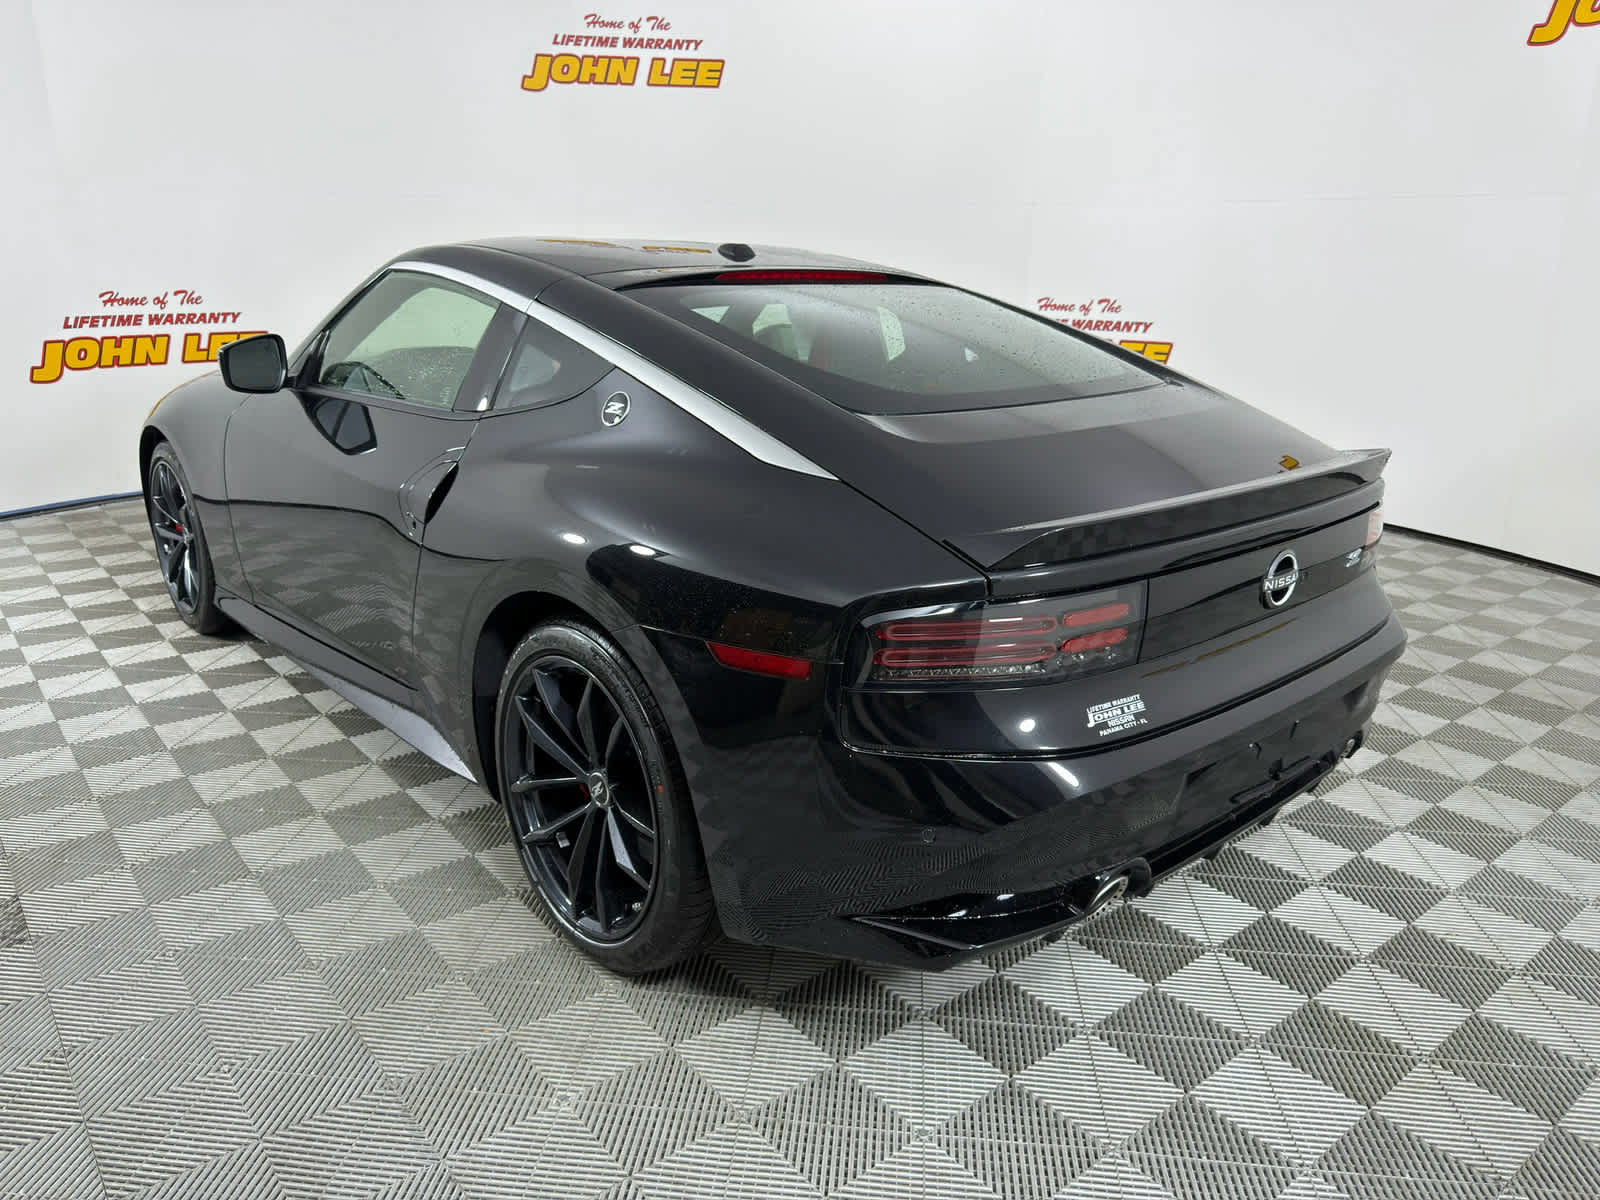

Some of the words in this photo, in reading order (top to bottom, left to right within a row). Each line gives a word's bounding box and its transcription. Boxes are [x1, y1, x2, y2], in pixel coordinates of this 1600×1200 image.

[584, 13, 624, 29] Home
[628, 17, 641, 33] of
[646, 16, 672, 31] The
[552, 33, 619, 48] LIFETIME
[622, 37, 703, 50] WARRANTY
[521, 53, 640, 91] JOHN
[647, 58, 725, 88] LEE
[99, 291, 148, 307] Home
[153, 292, 168, 309] of
[173, 290, 203, 306] The
[1037, 297, 1075, 311] Home
[1079, 300, 1094, 315] of
[1097, 298, 1122, 313] The
[63, 315, 143, 329] LIFETIME
[148, 312, 242, 326] WARRANTY
[1072, 319, 1152, 333] WARRANTY
[30, 334, 170, 383] JOHN
[605, 401, 625, 416] Z
[1087, 708, 1122, 728] JOHN
[1123, 701, 1145, 713] LEE
[1107, 714, 1135, 727] NISSAN
[1099, 726, 1124, 737] PANAMA
